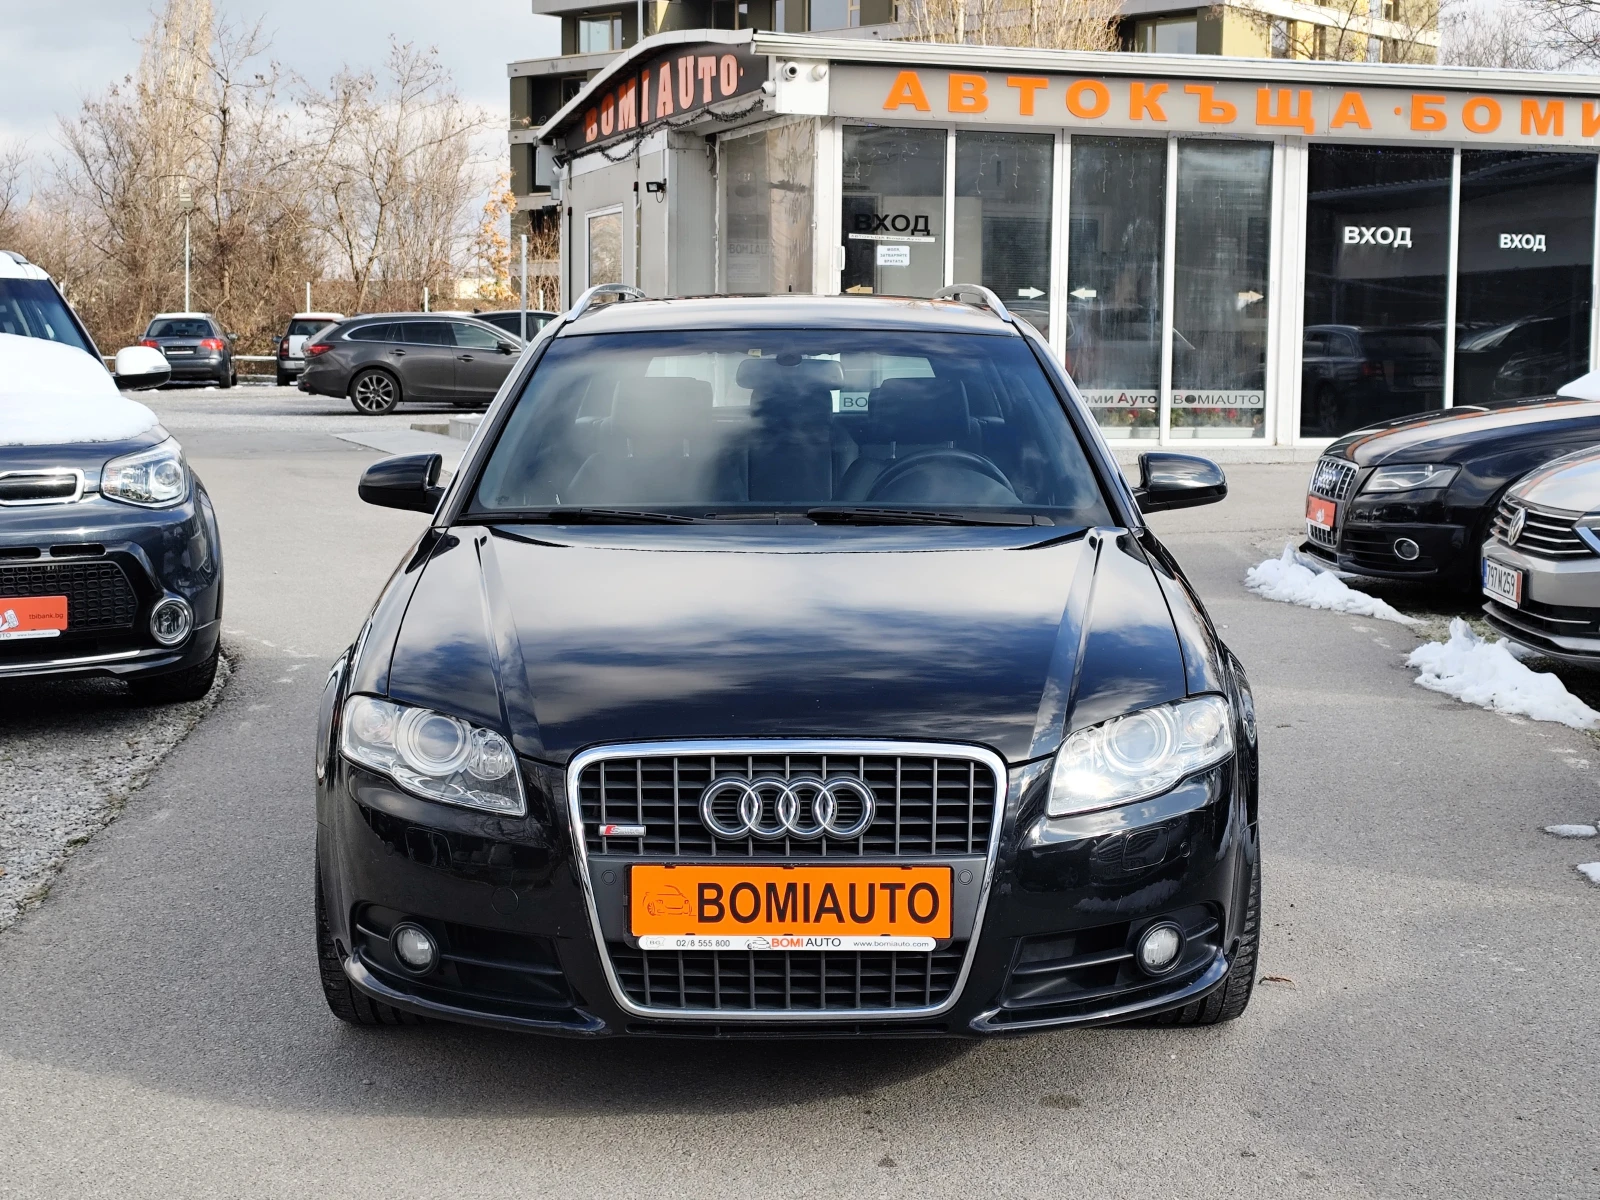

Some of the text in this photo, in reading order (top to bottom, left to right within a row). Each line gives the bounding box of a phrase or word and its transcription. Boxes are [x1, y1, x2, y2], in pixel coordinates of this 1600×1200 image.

[883, 70, 1373, 135] АВТОКЪЩА
[853, 213, 931, 236] ВХОД
[1343, 226, 1413, 249] ВХОД
[1499, 233, 1547, 252] ВХОД
[843, 397, 868, 408] BO
[1081, 394, 1114, 404] оми
[697, 882, 940, 924] BOMIAUTO
[853, 940, 929, 948] www.bomiauto.com
